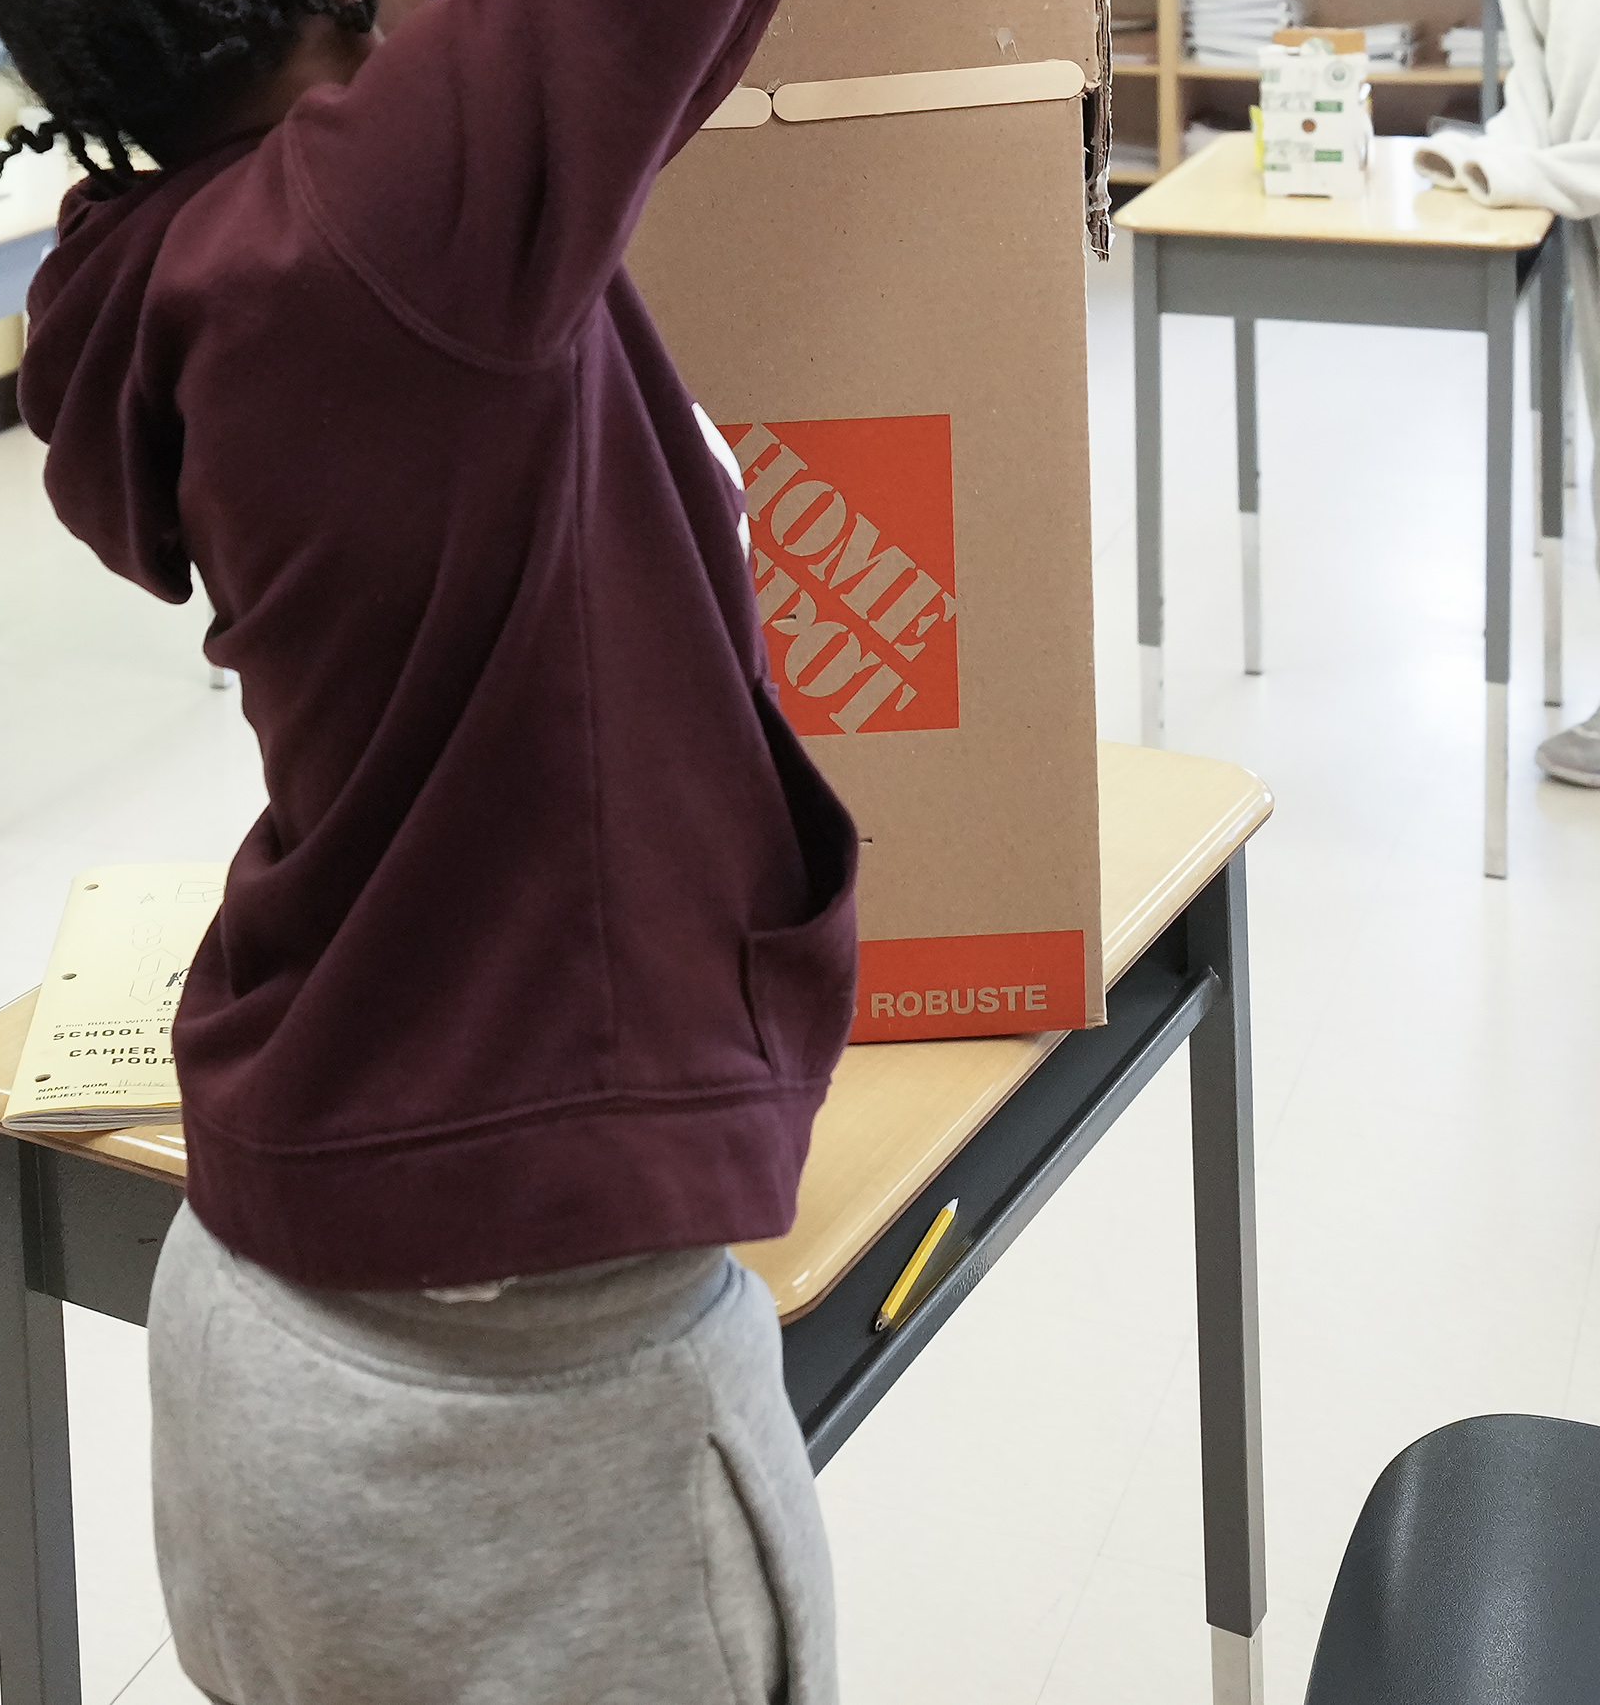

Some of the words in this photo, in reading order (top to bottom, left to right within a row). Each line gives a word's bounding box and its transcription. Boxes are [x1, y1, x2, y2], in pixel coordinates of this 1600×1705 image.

[732, 423, 956, 662] HOME
[870, 983, 1048, 1019] ROBUSTE
[53, 1027, 145, 1041] SCHOOL
[69, 1046, 156, 1058] CAHIER
[111, 1057, 175, 1065] POUR
[38, 1085, 70, 1093] NAME
[35, 1092, 83, 1101] SUBJECT
